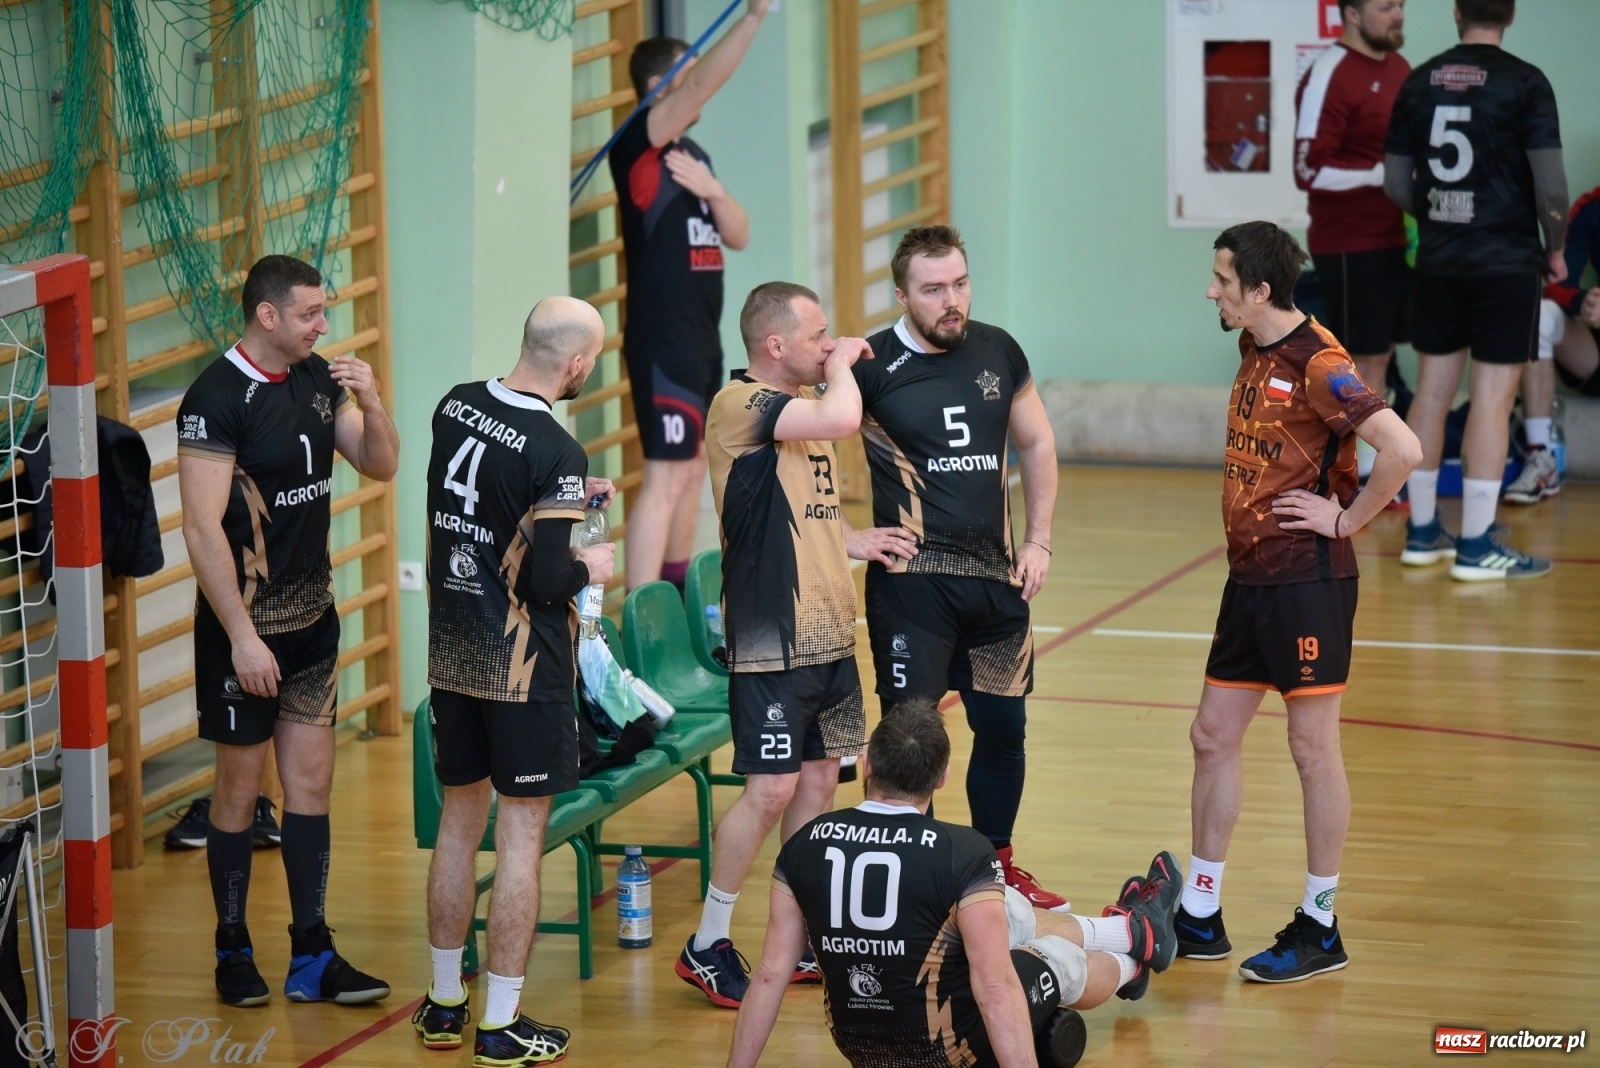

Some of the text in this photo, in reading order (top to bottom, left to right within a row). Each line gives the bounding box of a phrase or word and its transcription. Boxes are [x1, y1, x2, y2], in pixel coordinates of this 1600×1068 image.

[1428, 106, 1474, 182] 5
[1237, 383, 1257, 420] 19
[183, 414, 199, 423] DARK
[184, 423, 198, 432] SIDE
[442, 398, 527, 453] KOCZWARA
[662, 414, 685, 444] 10
[943, 405, 971, 448] 5
[300, 434, 313, 475] 1
[1227, 427, 1282, 461] ROTIM
[444, 436, 487, 516] 4
[927, 454, 998, 473] AGROTIM
[274, 477, 333, 508] AGROTIM
[558, 475, 579, 484] DARK
[562, 484, 579, 492] SIDE
[556, 492, 577, 500] CARS
[434, 511, 495, 545] AGROTIM
[1296, 636, 1319, 661] 19
[892, 662, 907, 688] 5
[227, 705, 236, 731] 1
[760, 733, 792, 760] 23
[514, 772, 549, 784] AGROTIM
[920, 828, 938, 848] R
[824, 846, 901, 931] 10
[1196, 873, 1214, 890] R
[822, 936, 905, 956] AGROTIM
